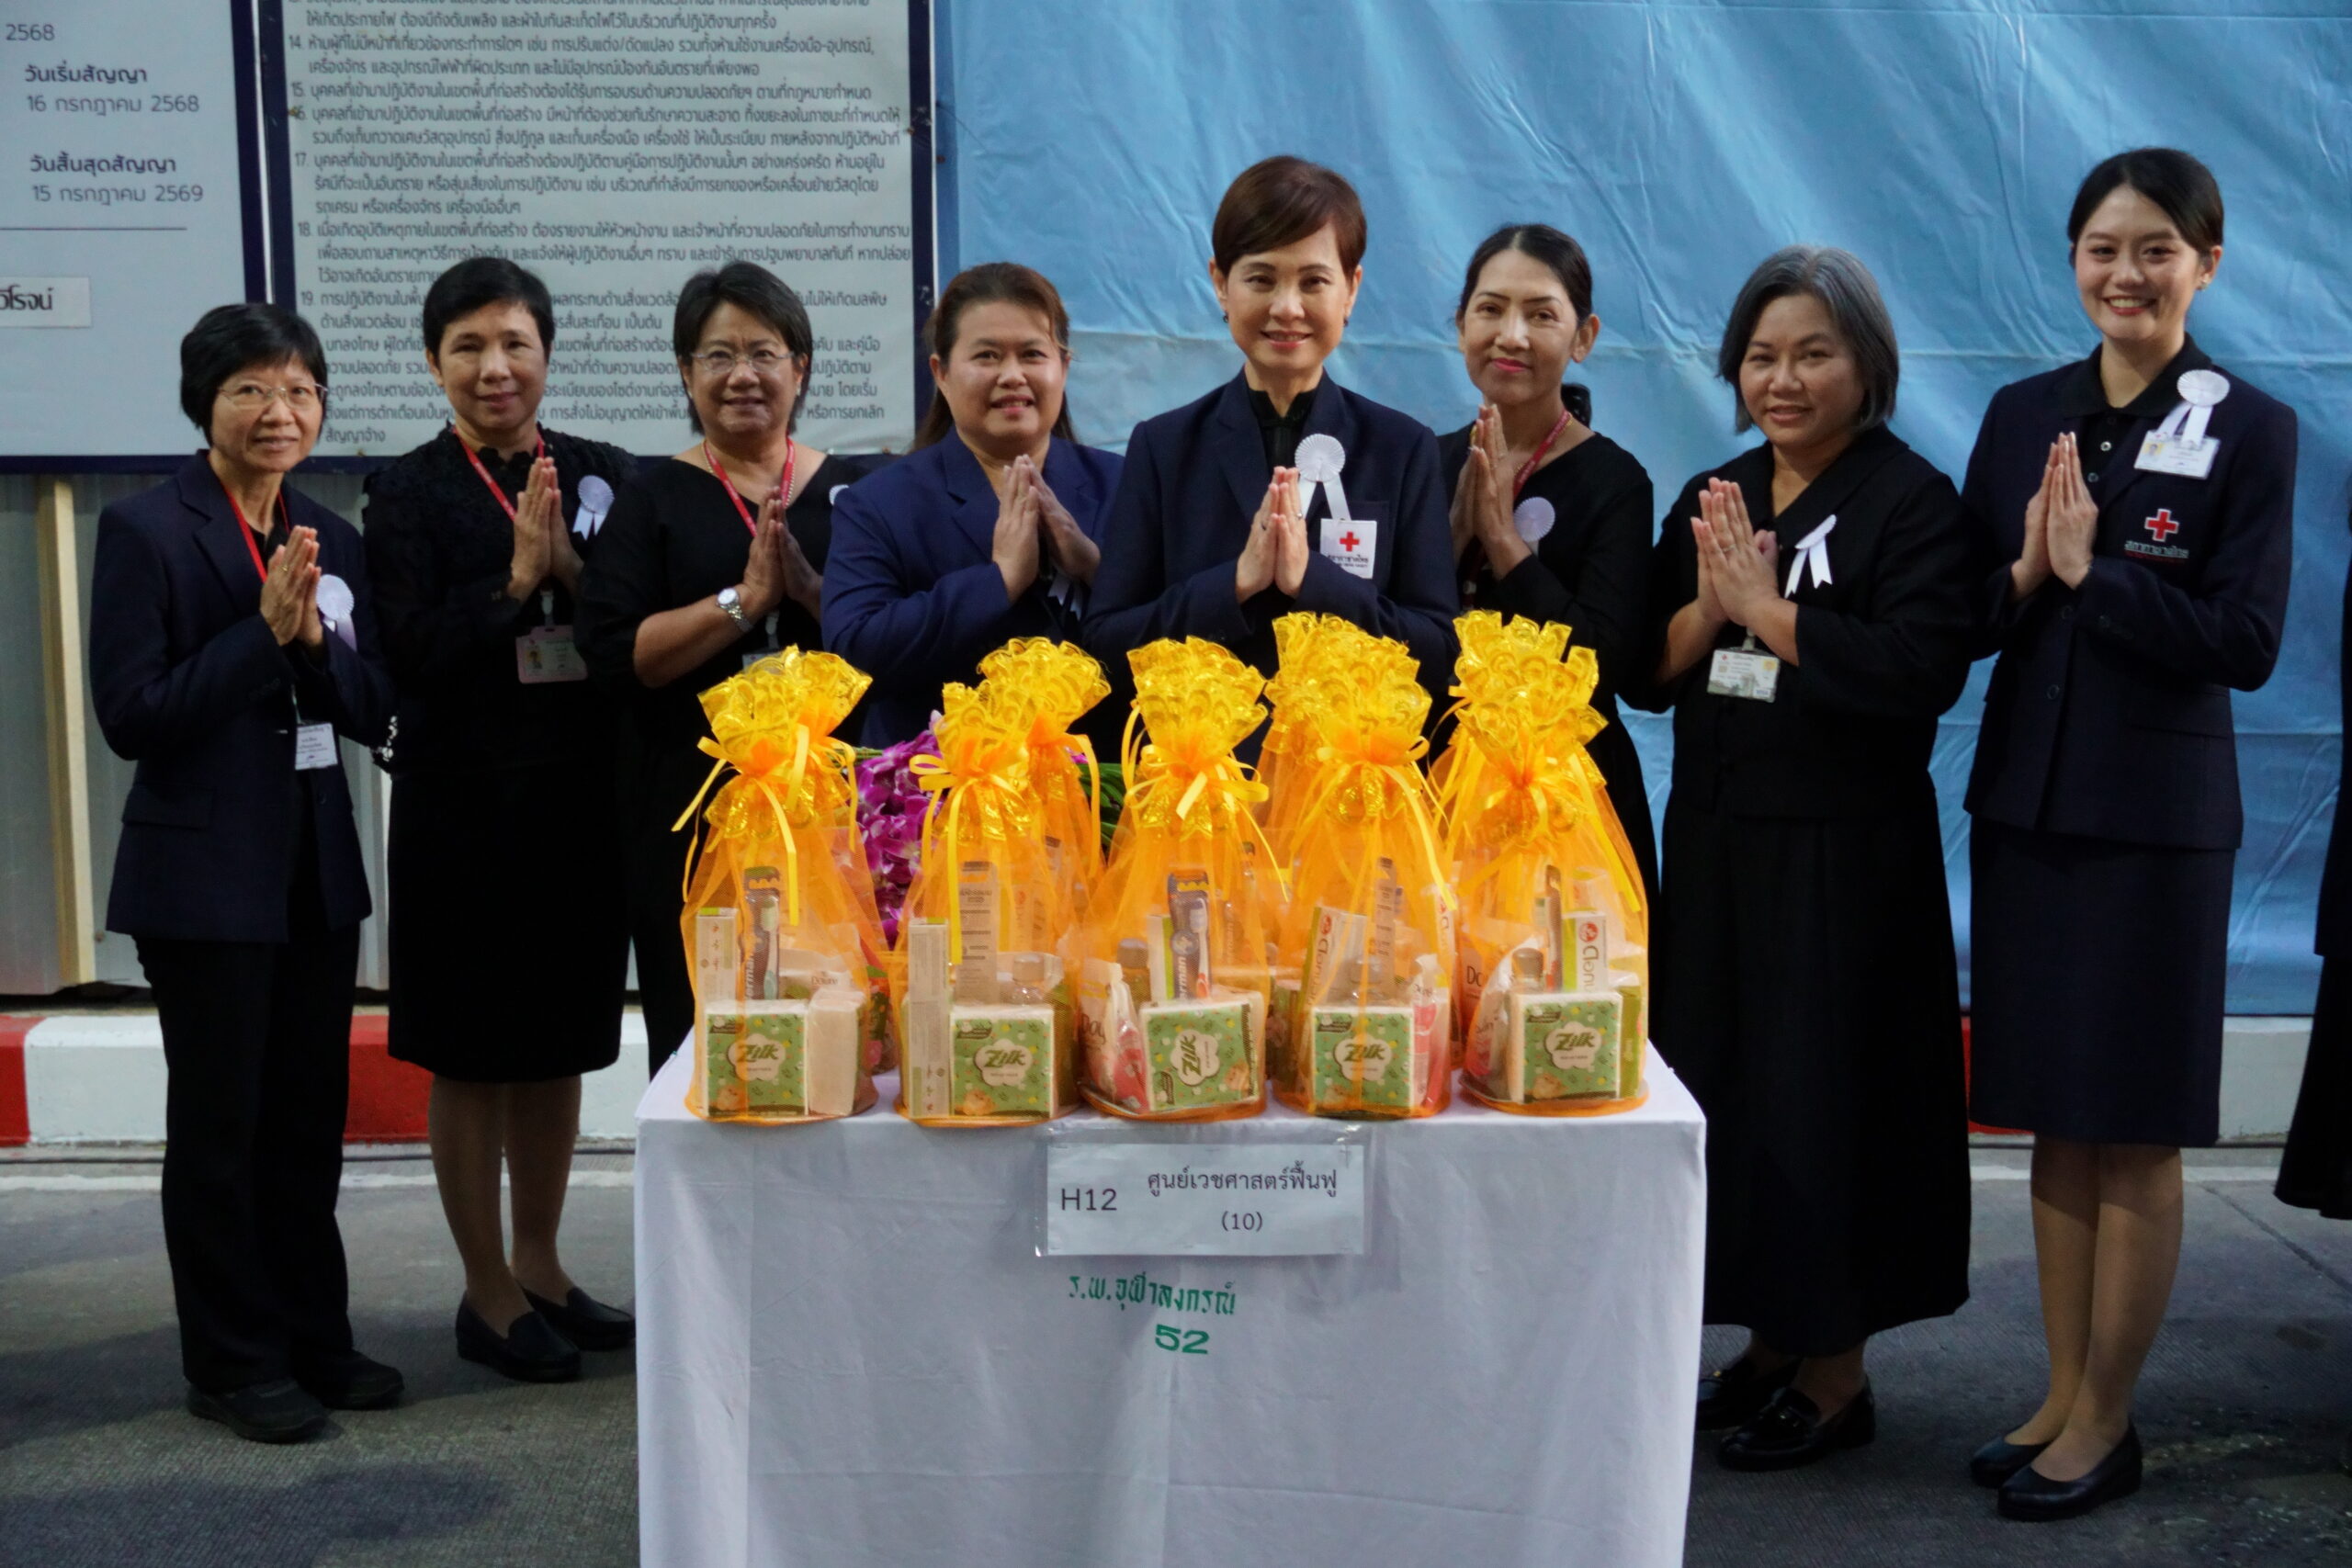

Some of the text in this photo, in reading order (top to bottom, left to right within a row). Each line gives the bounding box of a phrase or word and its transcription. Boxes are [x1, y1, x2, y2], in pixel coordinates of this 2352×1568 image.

[6, 24, 55, 41] 2568
[527, 36, 548, 51] เช่น
[25, 61, 147, 84] วันเริ่มสัญญา
[28, 96, 199, 117] 16 กรกฎาคม 2568
[30, 151, 176, 177] วันสิ้นสุดสัญญา
[586, 175, 606, 191] เช่น
[33, 186, 204, 206] 15 กรกฎาคม 2569
[411, 313, 424, 330] เช่
[1148, 1161, 1338, 1197] ศูนย์เวชศาสตร์ฟื้นฟู
[1060, 1189, 1117, 1211] H12
[1221, 1212, 1263, 1232] (10)
[1069, 1271, 1236, 1315] ร.พ.จุฬาลงกรณ์
[1154, 1324, 1210, 1355] 52
